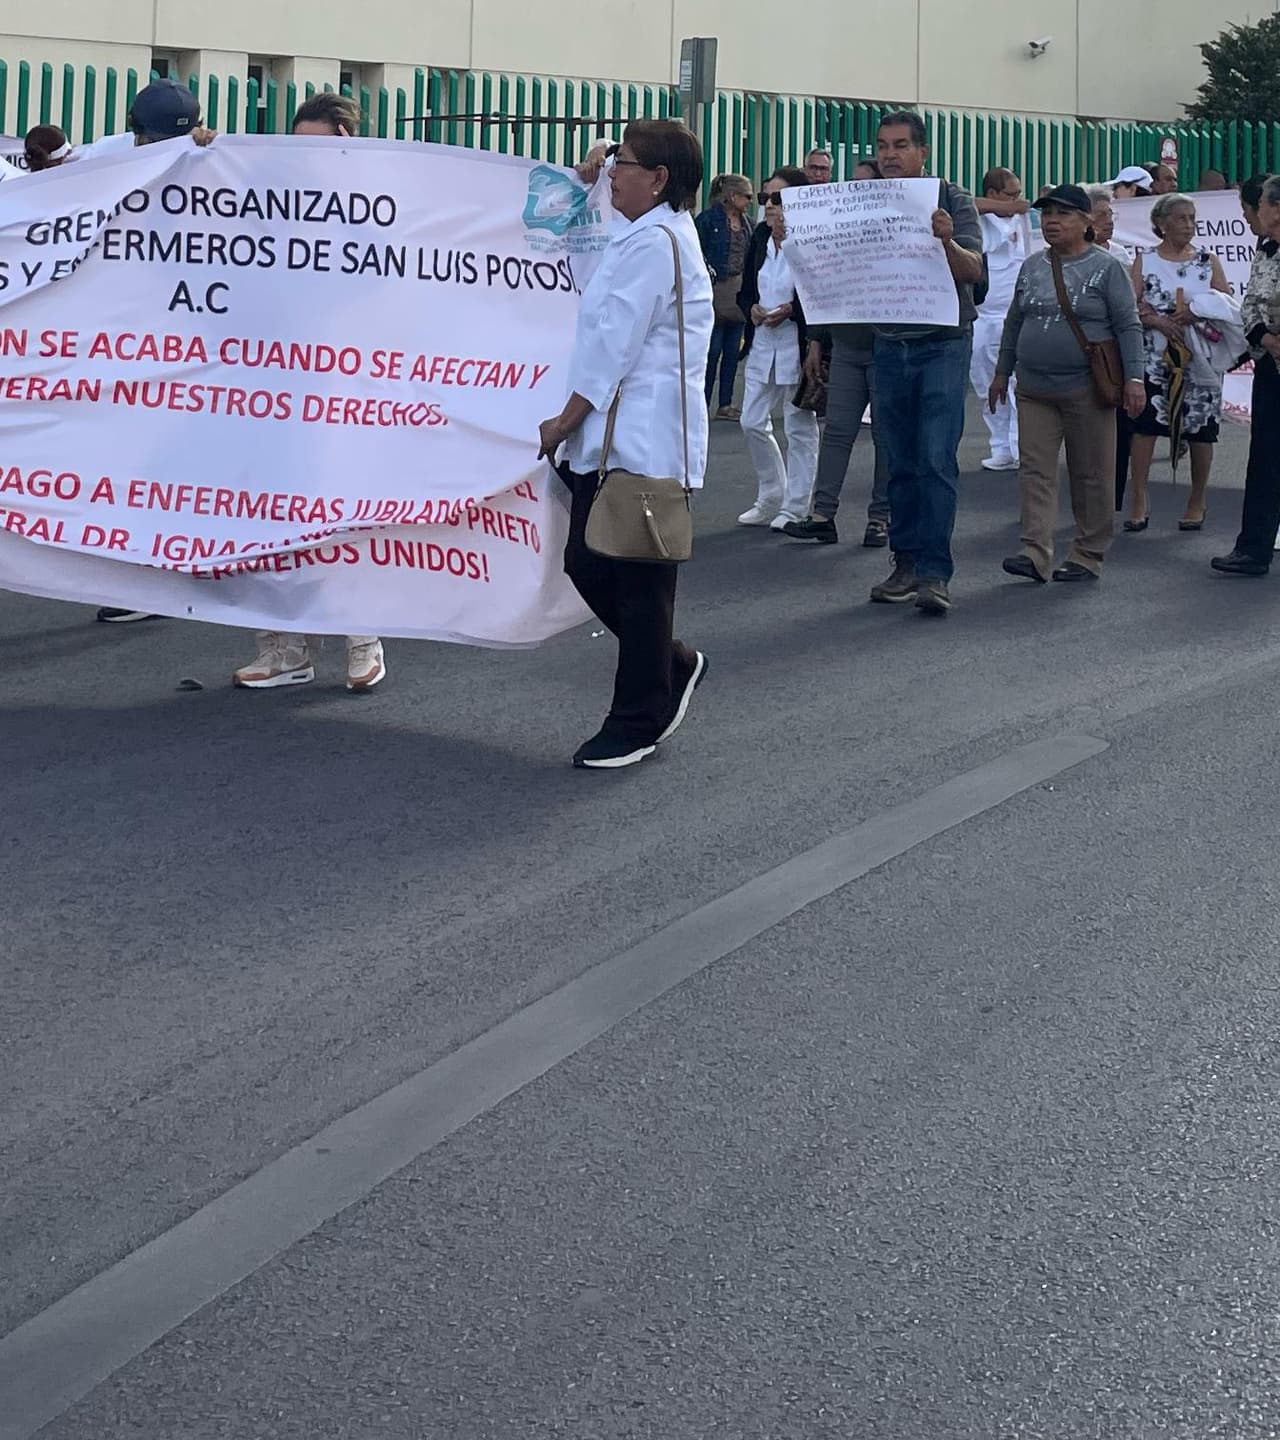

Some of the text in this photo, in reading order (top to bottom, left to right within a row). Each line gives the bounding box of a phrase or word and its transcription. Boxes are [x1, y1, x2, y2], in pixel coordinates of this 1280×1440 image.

[25, 184, 398, 246] GREO ORGANIZADO
[21, 261, 43, 286] Y
[287, 238, 331, 272] DE
[341, 241, 406, 278] SAN
[417, 247, 479, 284] LUIS
[168, 280, 231, 314] A.C
[39, 329, 79, 358] SE
[88, 332, 209, 363] ACABA
[219, 337, 362, 376] CUANDO
[370, 350, 405, 380] SE
[409, 354, 525, 389] AFECTAN
[528, 364, 551, 389] Y
[112, 381, 293, 420] NUESTROS
[90, 476, 115, 506] A
[127, 478, 345, 524] ENFERMERAS
[467, 506, 541, 554] PRIETO
[369, 537, 491, 583] UNIDOS!
